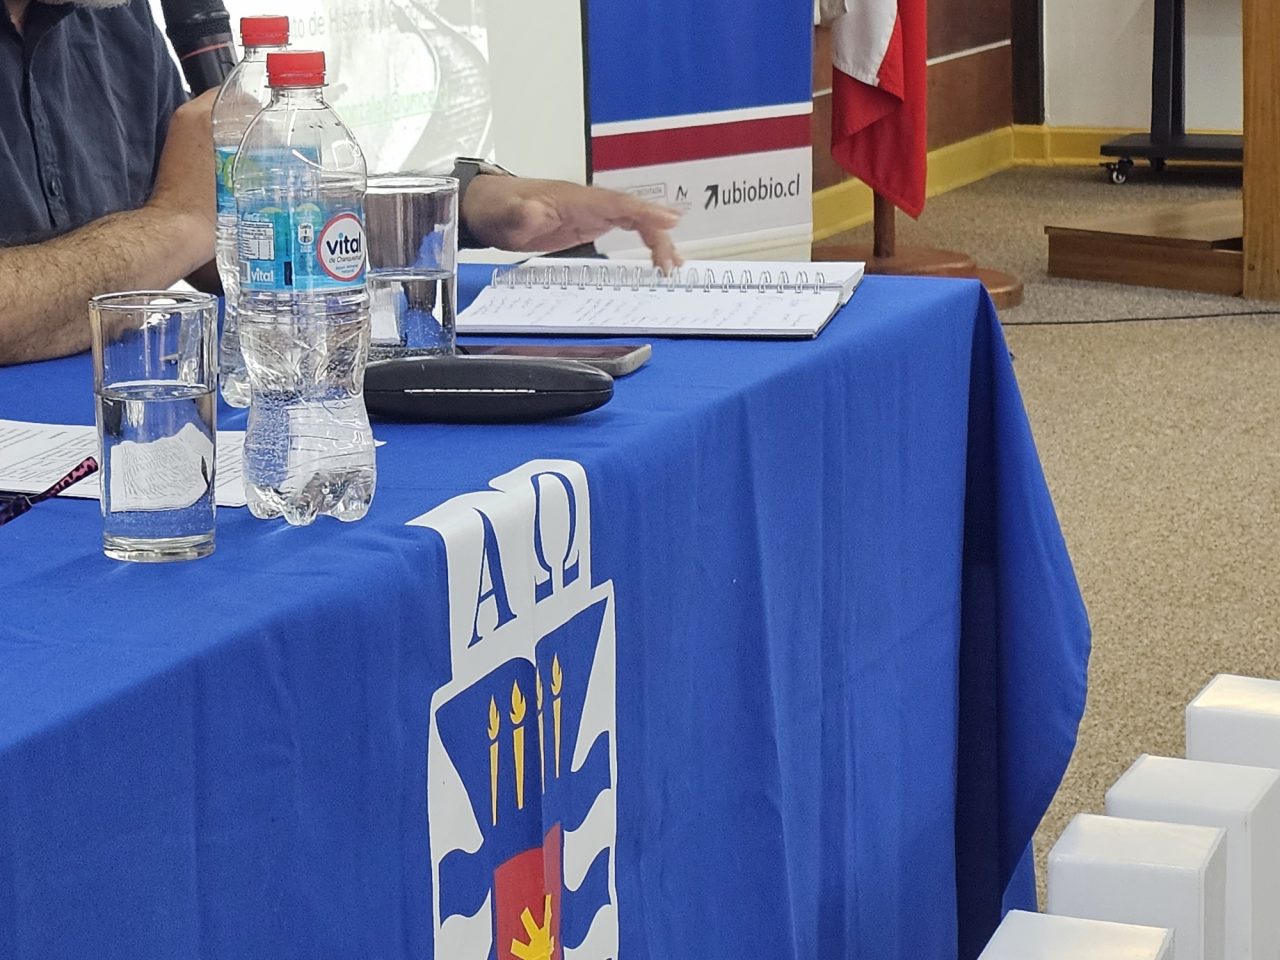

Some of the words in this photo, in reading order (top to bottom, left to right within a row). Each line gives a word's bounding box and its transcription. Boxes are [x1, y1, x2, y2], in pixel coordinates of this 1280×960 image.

[722, 173, 801, 206] ubiobio.cl
[326, 232, 362, 256] vital
[250, 267, 274, 283] vital
